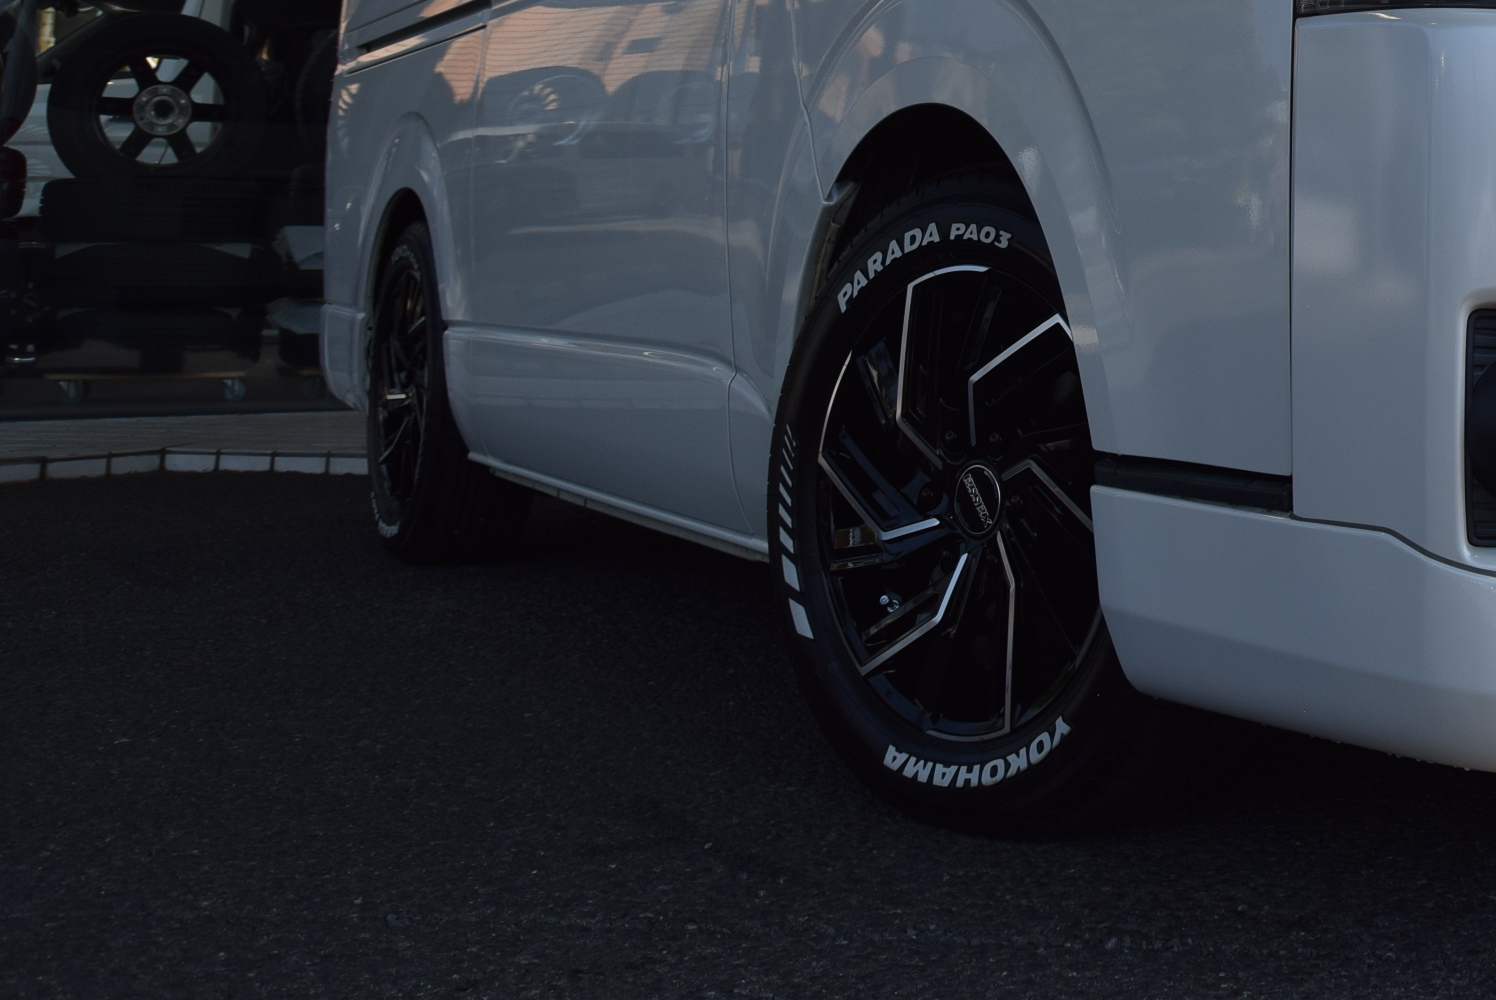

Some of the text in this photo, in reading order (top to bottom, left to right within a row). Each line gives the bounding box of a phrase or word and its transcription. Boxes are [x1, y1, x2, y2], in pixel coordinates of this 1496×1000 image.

[837, 222, 1011, 313] PARADA PA03
[962, 472, 993, 529] ESSEX
[883, 715, 1071, 789] YOKOHAMA
